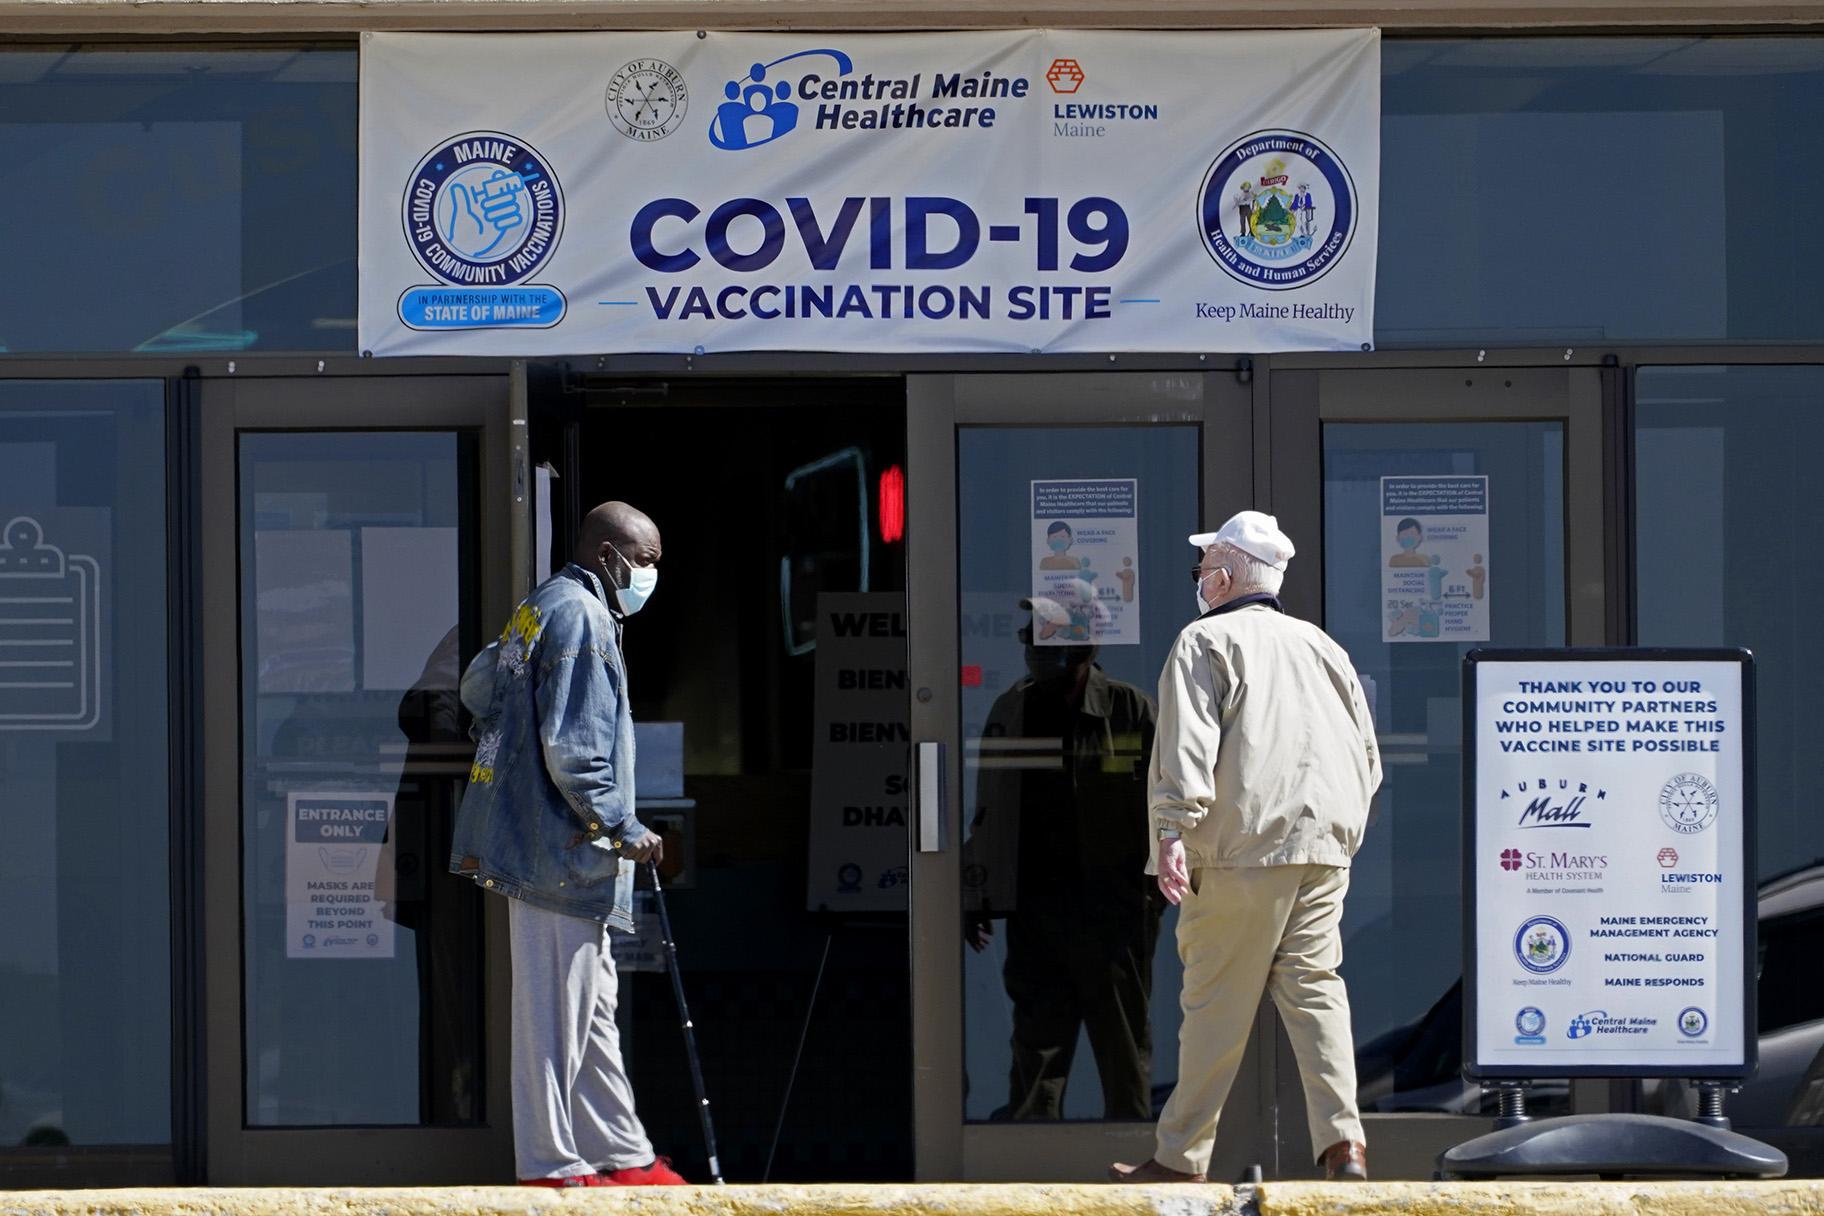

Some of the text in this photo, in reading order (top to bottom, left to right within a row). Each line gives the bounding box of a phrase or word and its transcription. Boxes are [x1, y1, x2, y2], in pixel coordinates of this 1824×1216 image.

[607, 71, 625, 102] CITY
[627, 61, 645, 73] OF
[649, 62, 687, 102] AUBURN
[798, 71, 1029, 100] Central Maine
[815, 103, 997, 130] Healthcare
[1054, 103, 1159, 120] LEWISTON
[625, 126, 670, 140] MAINE
[1053, 122, 1106, 138] Maine
[453, 141, 517, 164] MAINE
[1236, 138, 1321, 161] Department of
[413, 178, 553, 283] COVID-19 COMMUNITY VACCINATIONS
[629, 196, 1131, 274] COVID-19
[1209, 229, 1238, 264] Health
[1238, 260, 1260, 277] and
[1263, 267, 1307, 281] Human
[1306, 231, 1343, 273] Services
[418, 294, 547, 305] IN PARTNERSHIP WITH THE
[645, 285, 1112, 322] VACCINATION SITE
[424, 305, 541, 321] STATE OF MAINE
[1195, 302, 1355, 324] Keep Maine Healthy
[1519, 681, 1702, 694] THANK YOU TO OUR
[1503, 701, 1718, 714] COMMUNITY PARTNERS
[1496, 720, 1726, 733] WHO HELPED MAKE THIS
[1500, 740, 1720, 752] VACCINE SITE POSSIBLE
[1500, 778, 1607, 800] AUBURN
[298, 808, 385, 821] ENTRANCE
[1518, 796, 1587, 826] Mall
[320, 825, 364, 837] ONLY
[1526, 872, 1603, 880] HEALTH SYSTEM
[1661, 873, 1722, 883] LEWISTON
[307, 881, 375, 890] MASKS ARE
[1661, 884, 1692, 894] Maine
[310, 894, 371, 905] REQUIRED
[316, 907, 365, 916] BEYOND
[307, 920, 374, 929] THIS POINT
[1600, 916, 1708, 925] MAINE EMERGENCY
[1590, 929, 1719, 938] MANAGEMENT AGENCY
[1604, 953, 1705, 962] NATIONAL GUARD
[1512, 979, 1528, 987] Keep
[1548, 978, 1572, 987] Healthy
[1604, 978, 1705, 987] MAINE RESPONDS
[1591, 1017, 1657, 1026] Central Maine
[1596, 1026, 1648, 1034] Healthcare
